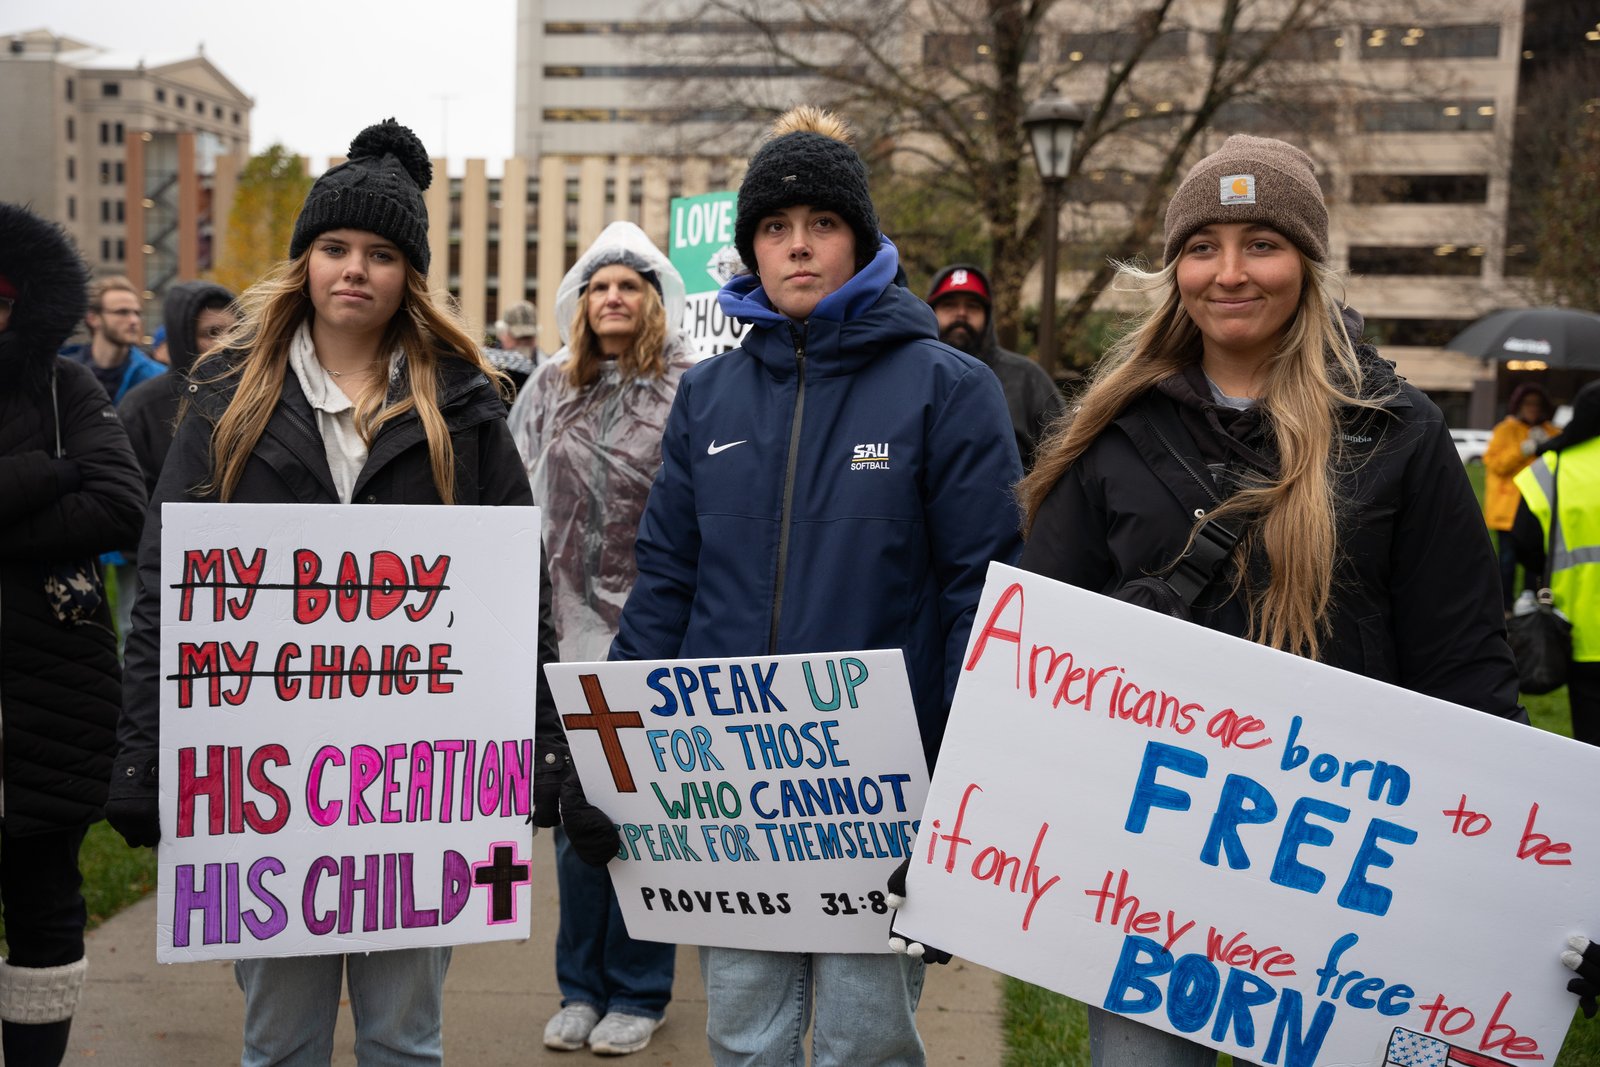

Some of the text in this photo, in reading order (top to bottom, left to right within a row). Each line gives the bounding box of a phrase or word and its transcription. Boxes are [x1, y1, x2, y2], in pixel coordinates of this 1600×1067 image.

[675, 200, 733, 249] LOVE
[681, 299, 744, 339] CHOO
[851, 461, 890, 470] SOFTBALL
[853, 442, 889, 458] SAU
[179, 548, 454, 627] MY BODY,
[178, 641, 455, 708] MY CHOICE
[646, 657, 868, 717] SPEAK UP
[646, 719, 849, 772] FOR THOSE
[965, 583, 1572, 865] Americans are born to be
[176, 743, 291, 838] HIS
[650, 773, 911, 819] WHO CANNOT
[702, 823, 759, 861] FOR
[756, 819, 921, 862] THEMSELVE
[1124, 740, 1418, 916] FREE
[173, 850, 471, 947] HIS CHILD
[640, 886, 888, 915] PROVERBS 31:8
[927, 783, 983, 873] if
[971, 822, 1061, 931] only
[1084, 868, 1196, 954] they
[1316, 932, 1415, 1016] free
[1418, 993, 1475, 1036] to
[1479, 991, 1544, 1060] be
[1103, 935, 1336, 1067] BORN
